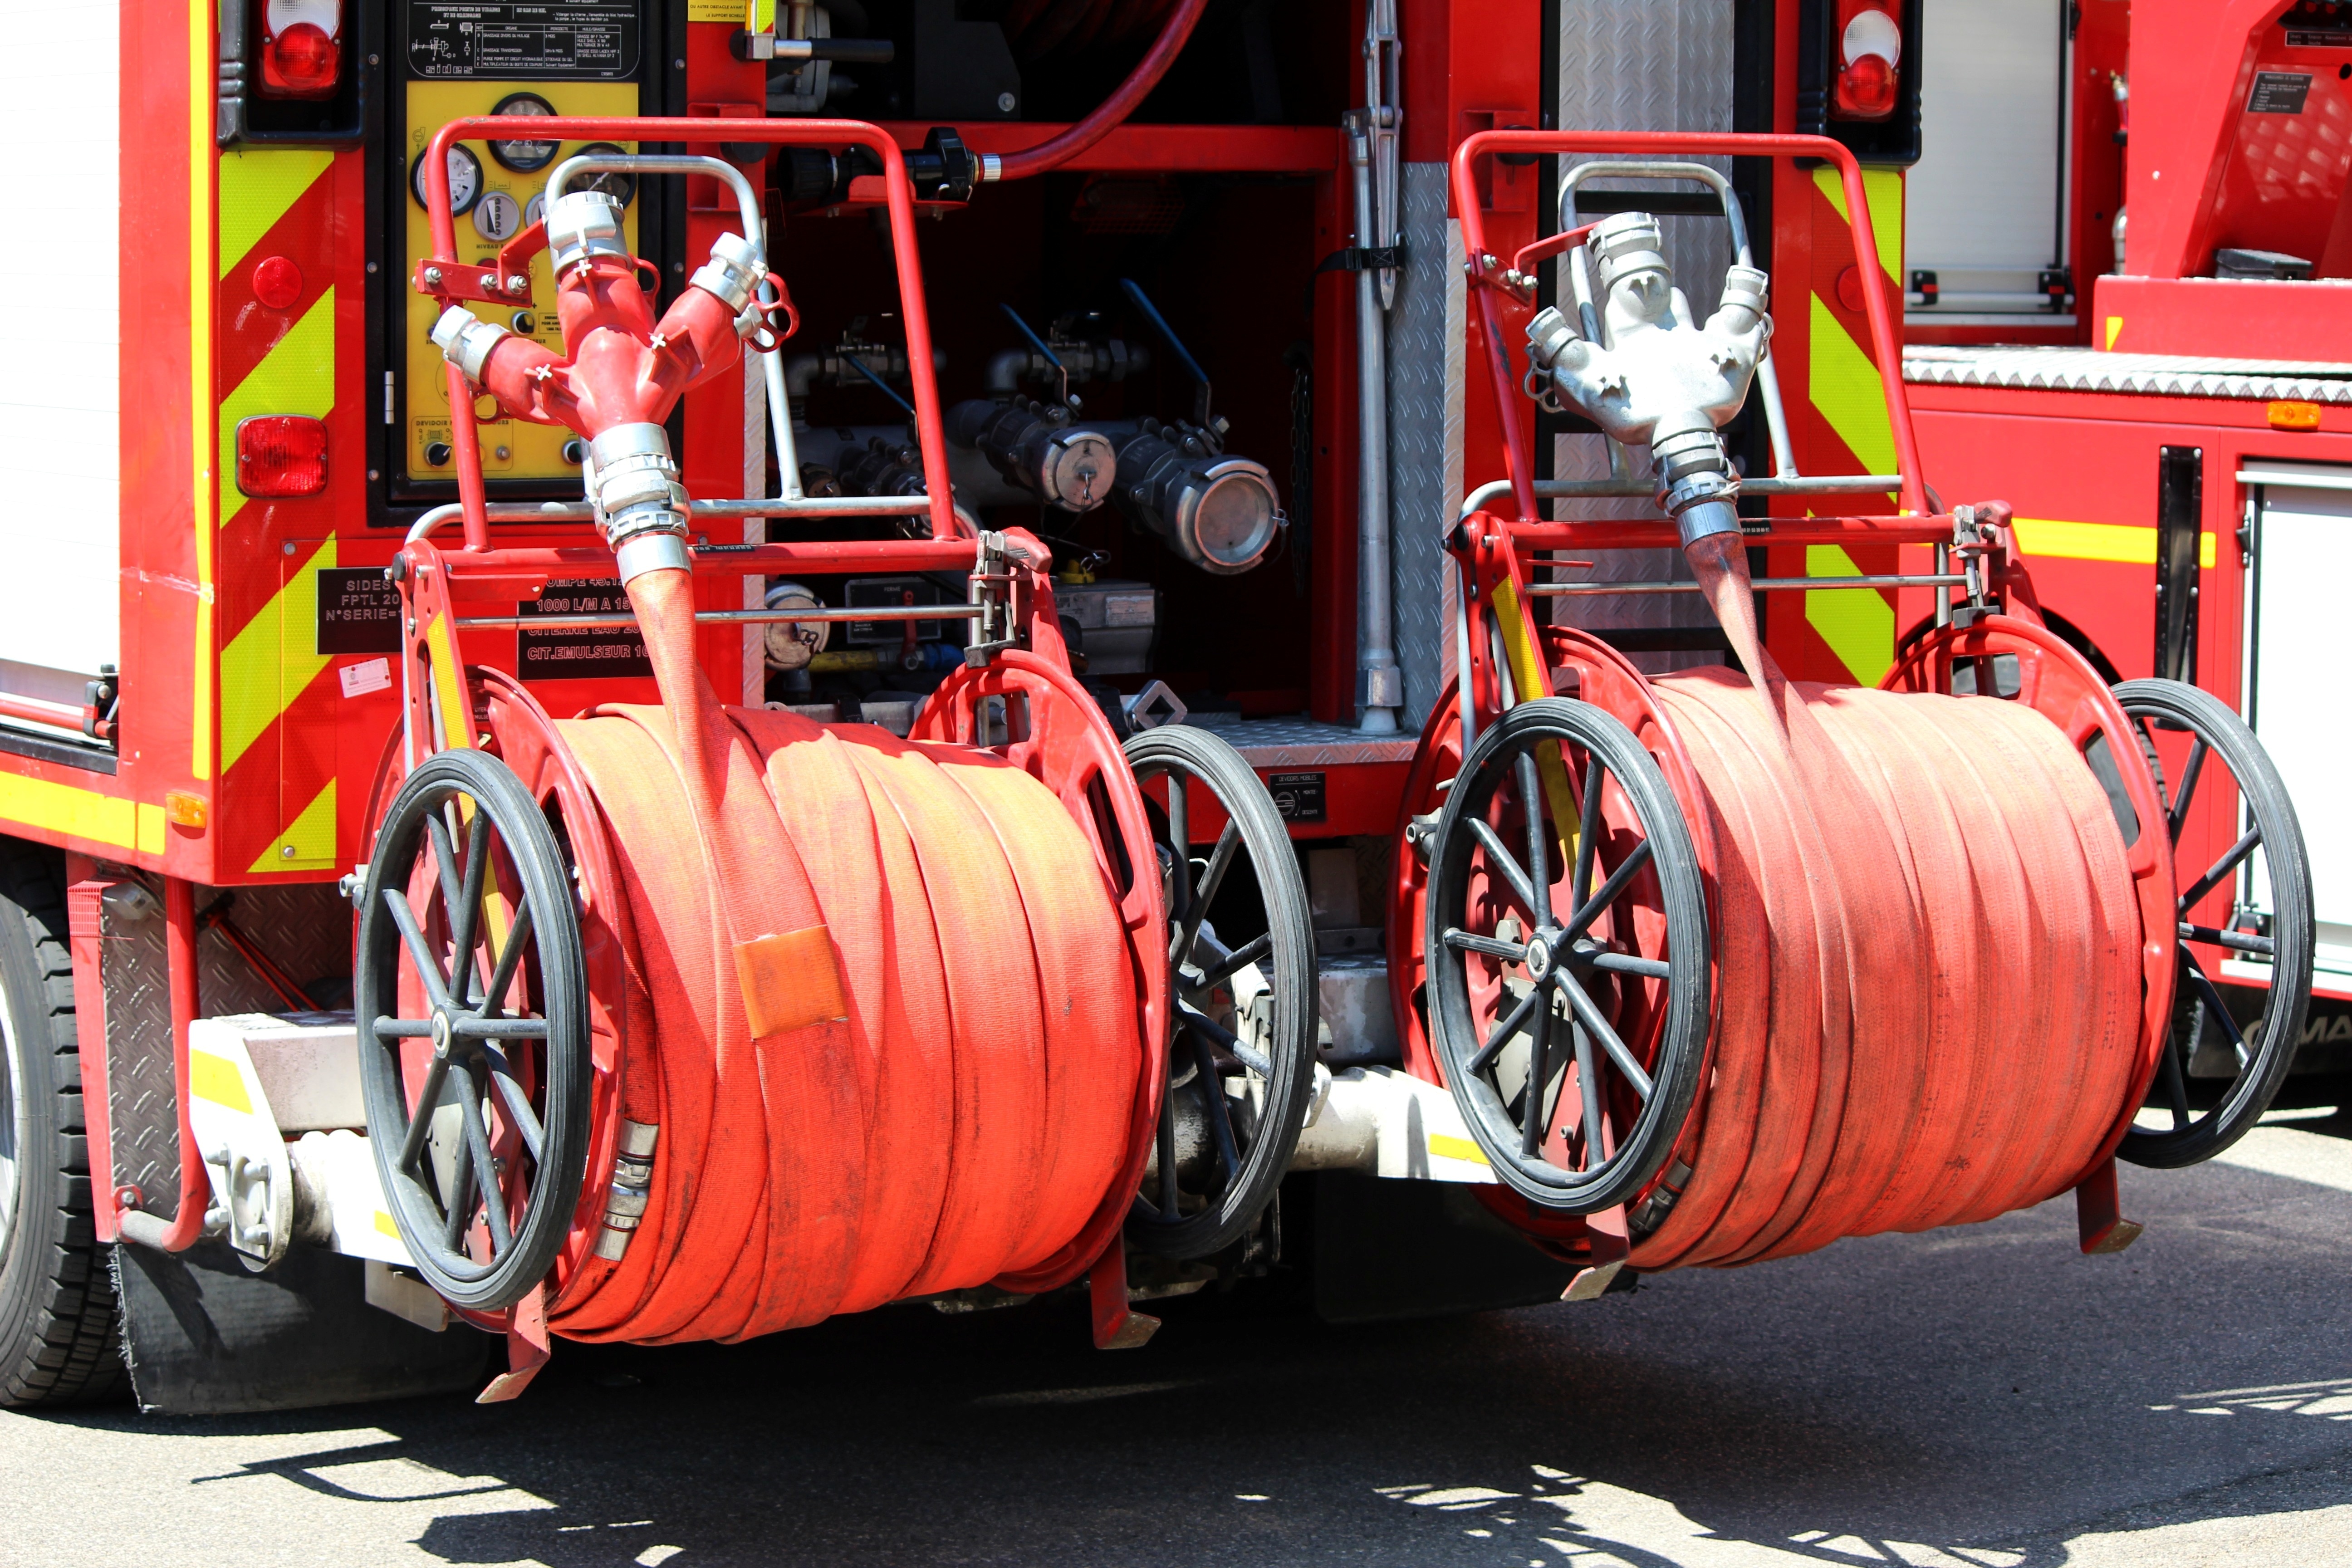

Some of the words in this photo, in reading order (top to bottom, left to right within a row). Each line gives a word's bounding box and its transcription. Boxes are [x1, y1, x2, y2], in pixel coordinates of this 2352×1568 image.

[346, 580, 391, 591] SIDES
[546, 579, 586, 587] OMPE
[341, 595, 377, 605] FPTL
[537, 599, 570, 611] 1000
[573, 598, 597, 612] L/M
[601, 598, 611, 610] A
[528, 645, 630, 660] CIT.EMULSEUR
